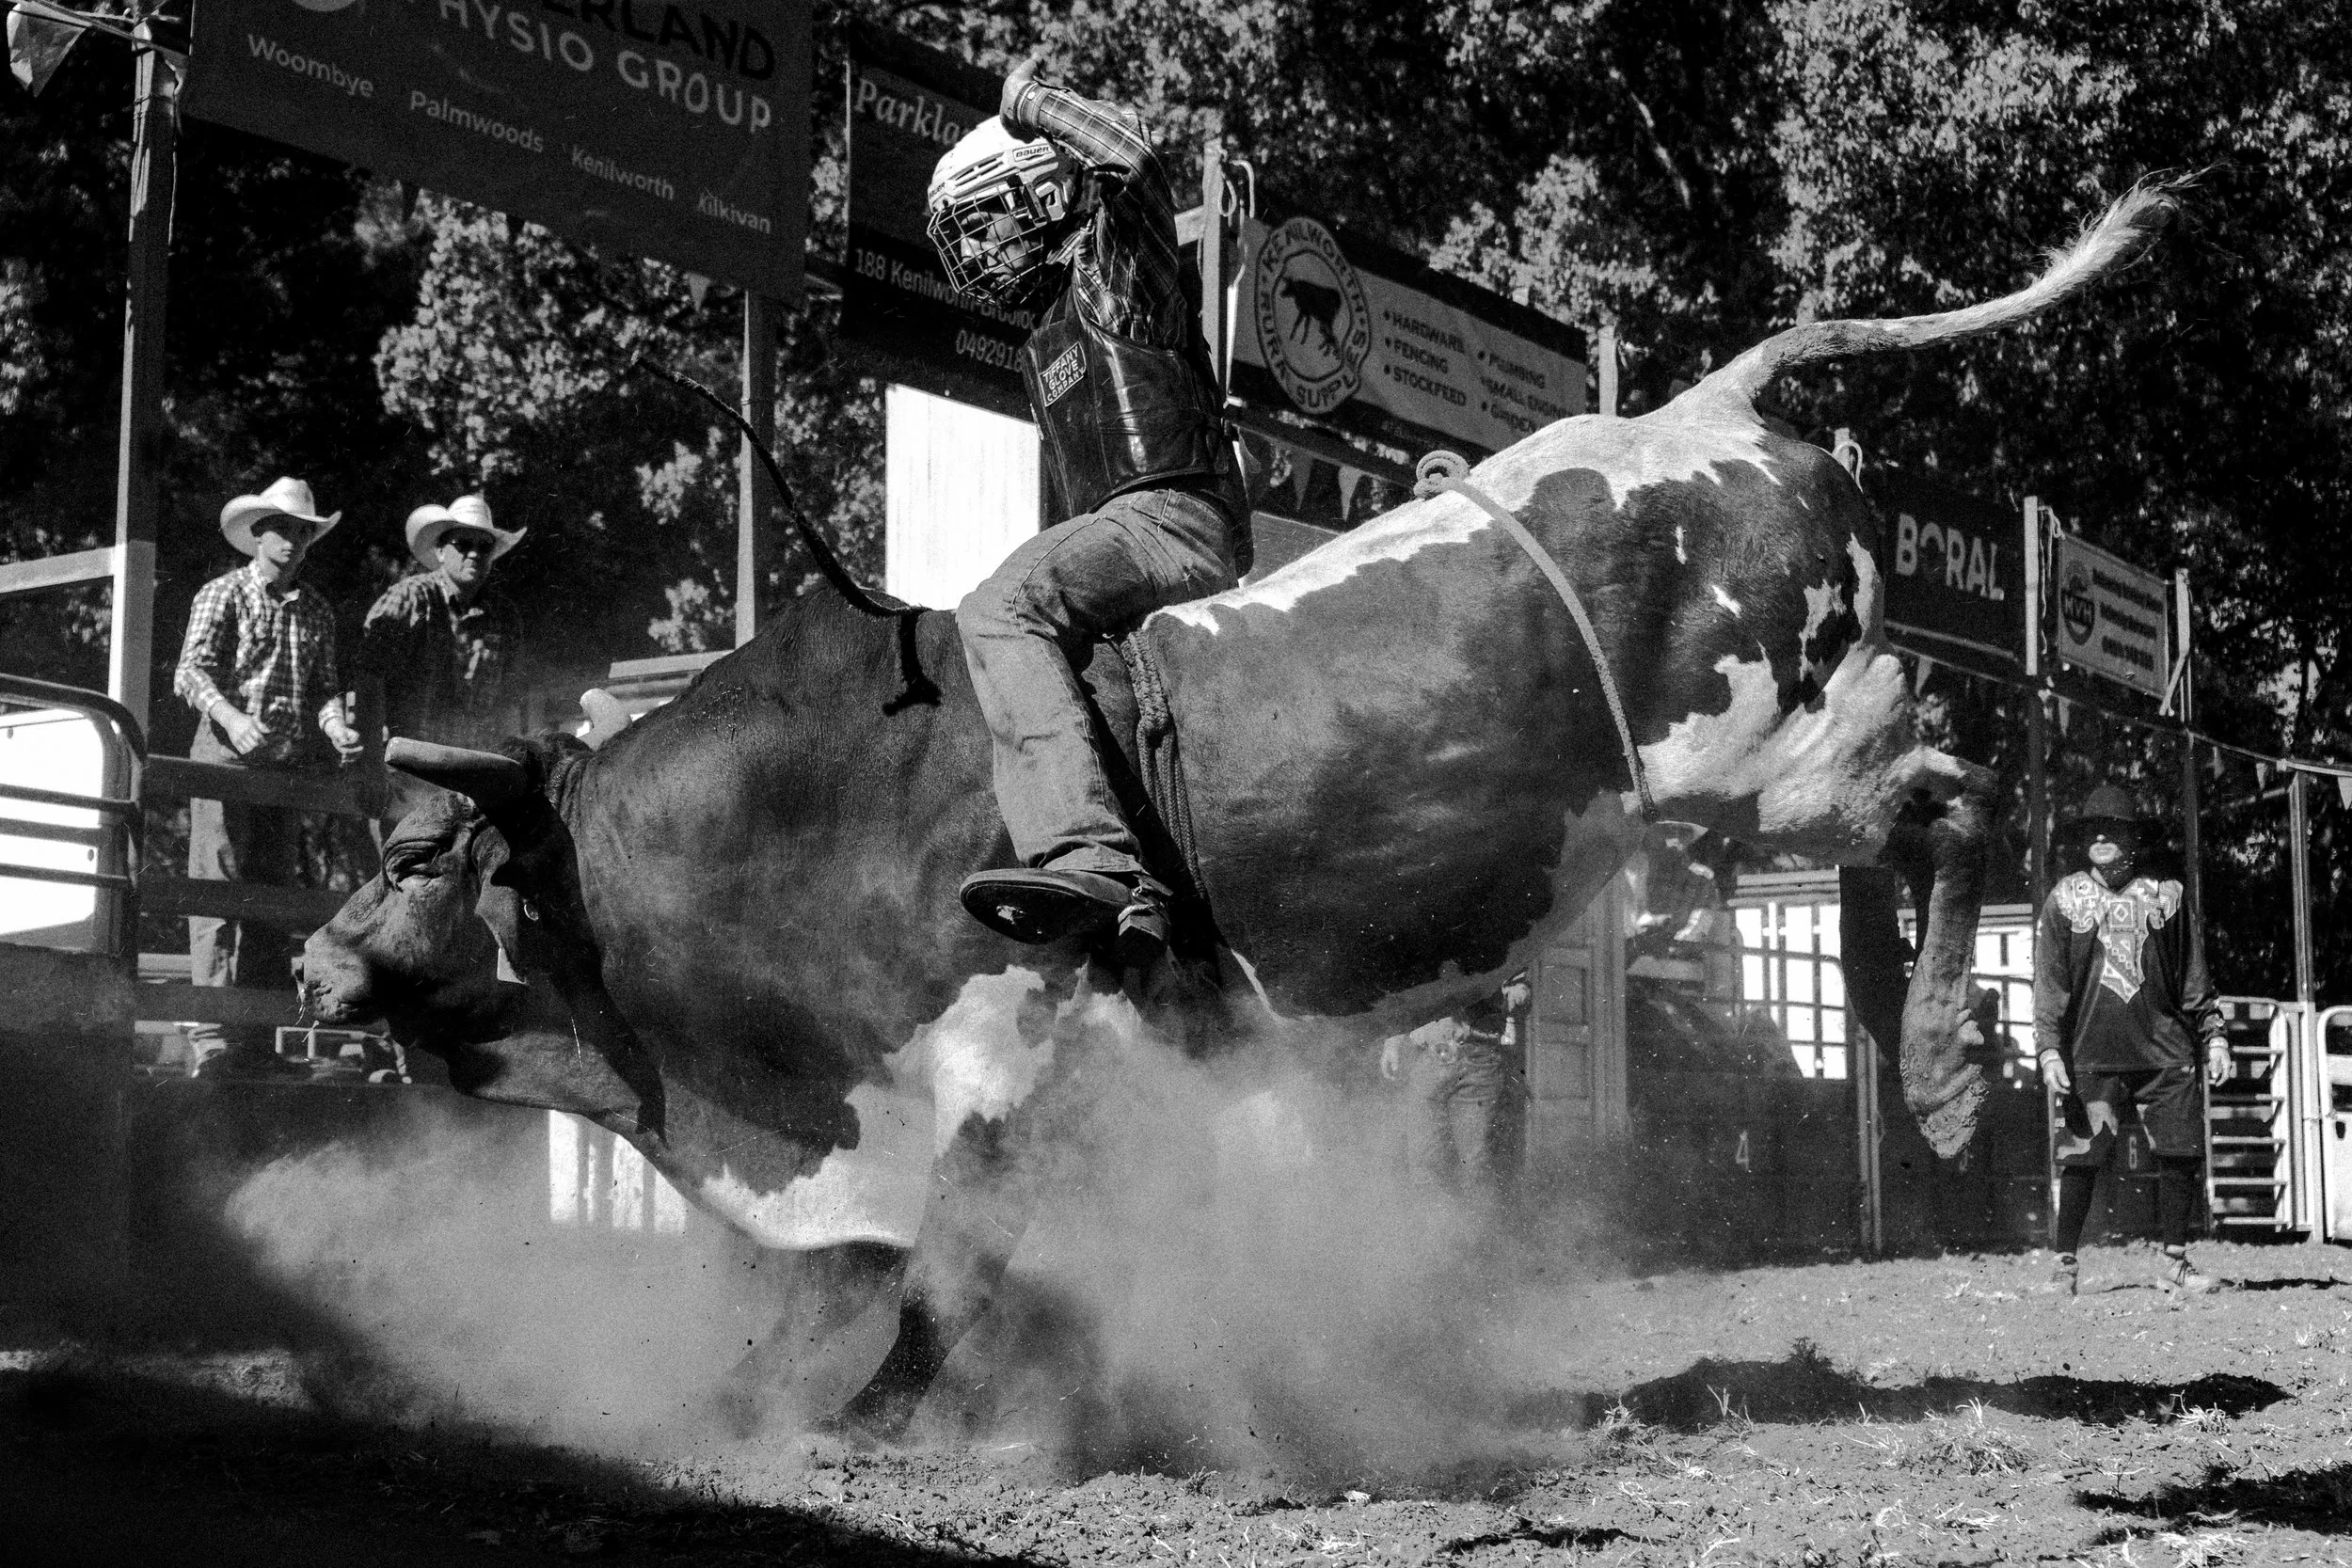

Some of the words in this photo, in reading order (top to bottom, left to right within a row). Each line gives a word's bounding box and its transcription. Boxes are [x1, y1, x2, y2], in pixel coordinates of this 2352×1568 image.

[542, 0, 774, 81] RLAND
[410, 0, 595, 72] HYSIO
[616, 49, 772, 135] GROUP
[853, 78, 970, 146] Parkla
[246, 33, 374, 99] Woombye
[409, 89, 544, 154] Palmwoods
[570, 144, 675, 201] Kenilworth
[696, 191, 772, 235] Kilkivan
[853, 247, 887, 282] 188
[1260, 293, 1287, 380] RURA
[1391, 310, 1466, 355] HARDWARE
[1042, 345, 1078, 383] TIFFANY
[1048, 359, 1079, 390] GLOVE
[1295, 330, 1367, 407] SUPPLES
[1393, 338, 1450, 374] FENCING
[1046, 367, 1085, 403] COMPANY
[1393, 365, 1468, 407] STOCKFEED
[1490, 402, 1538, 433] GDEN
[1895, 512, 2006, 601] BORAL
[1735, 1130, 1750, 1172] 4
[2128, 1134, 2138, 1170] 6
